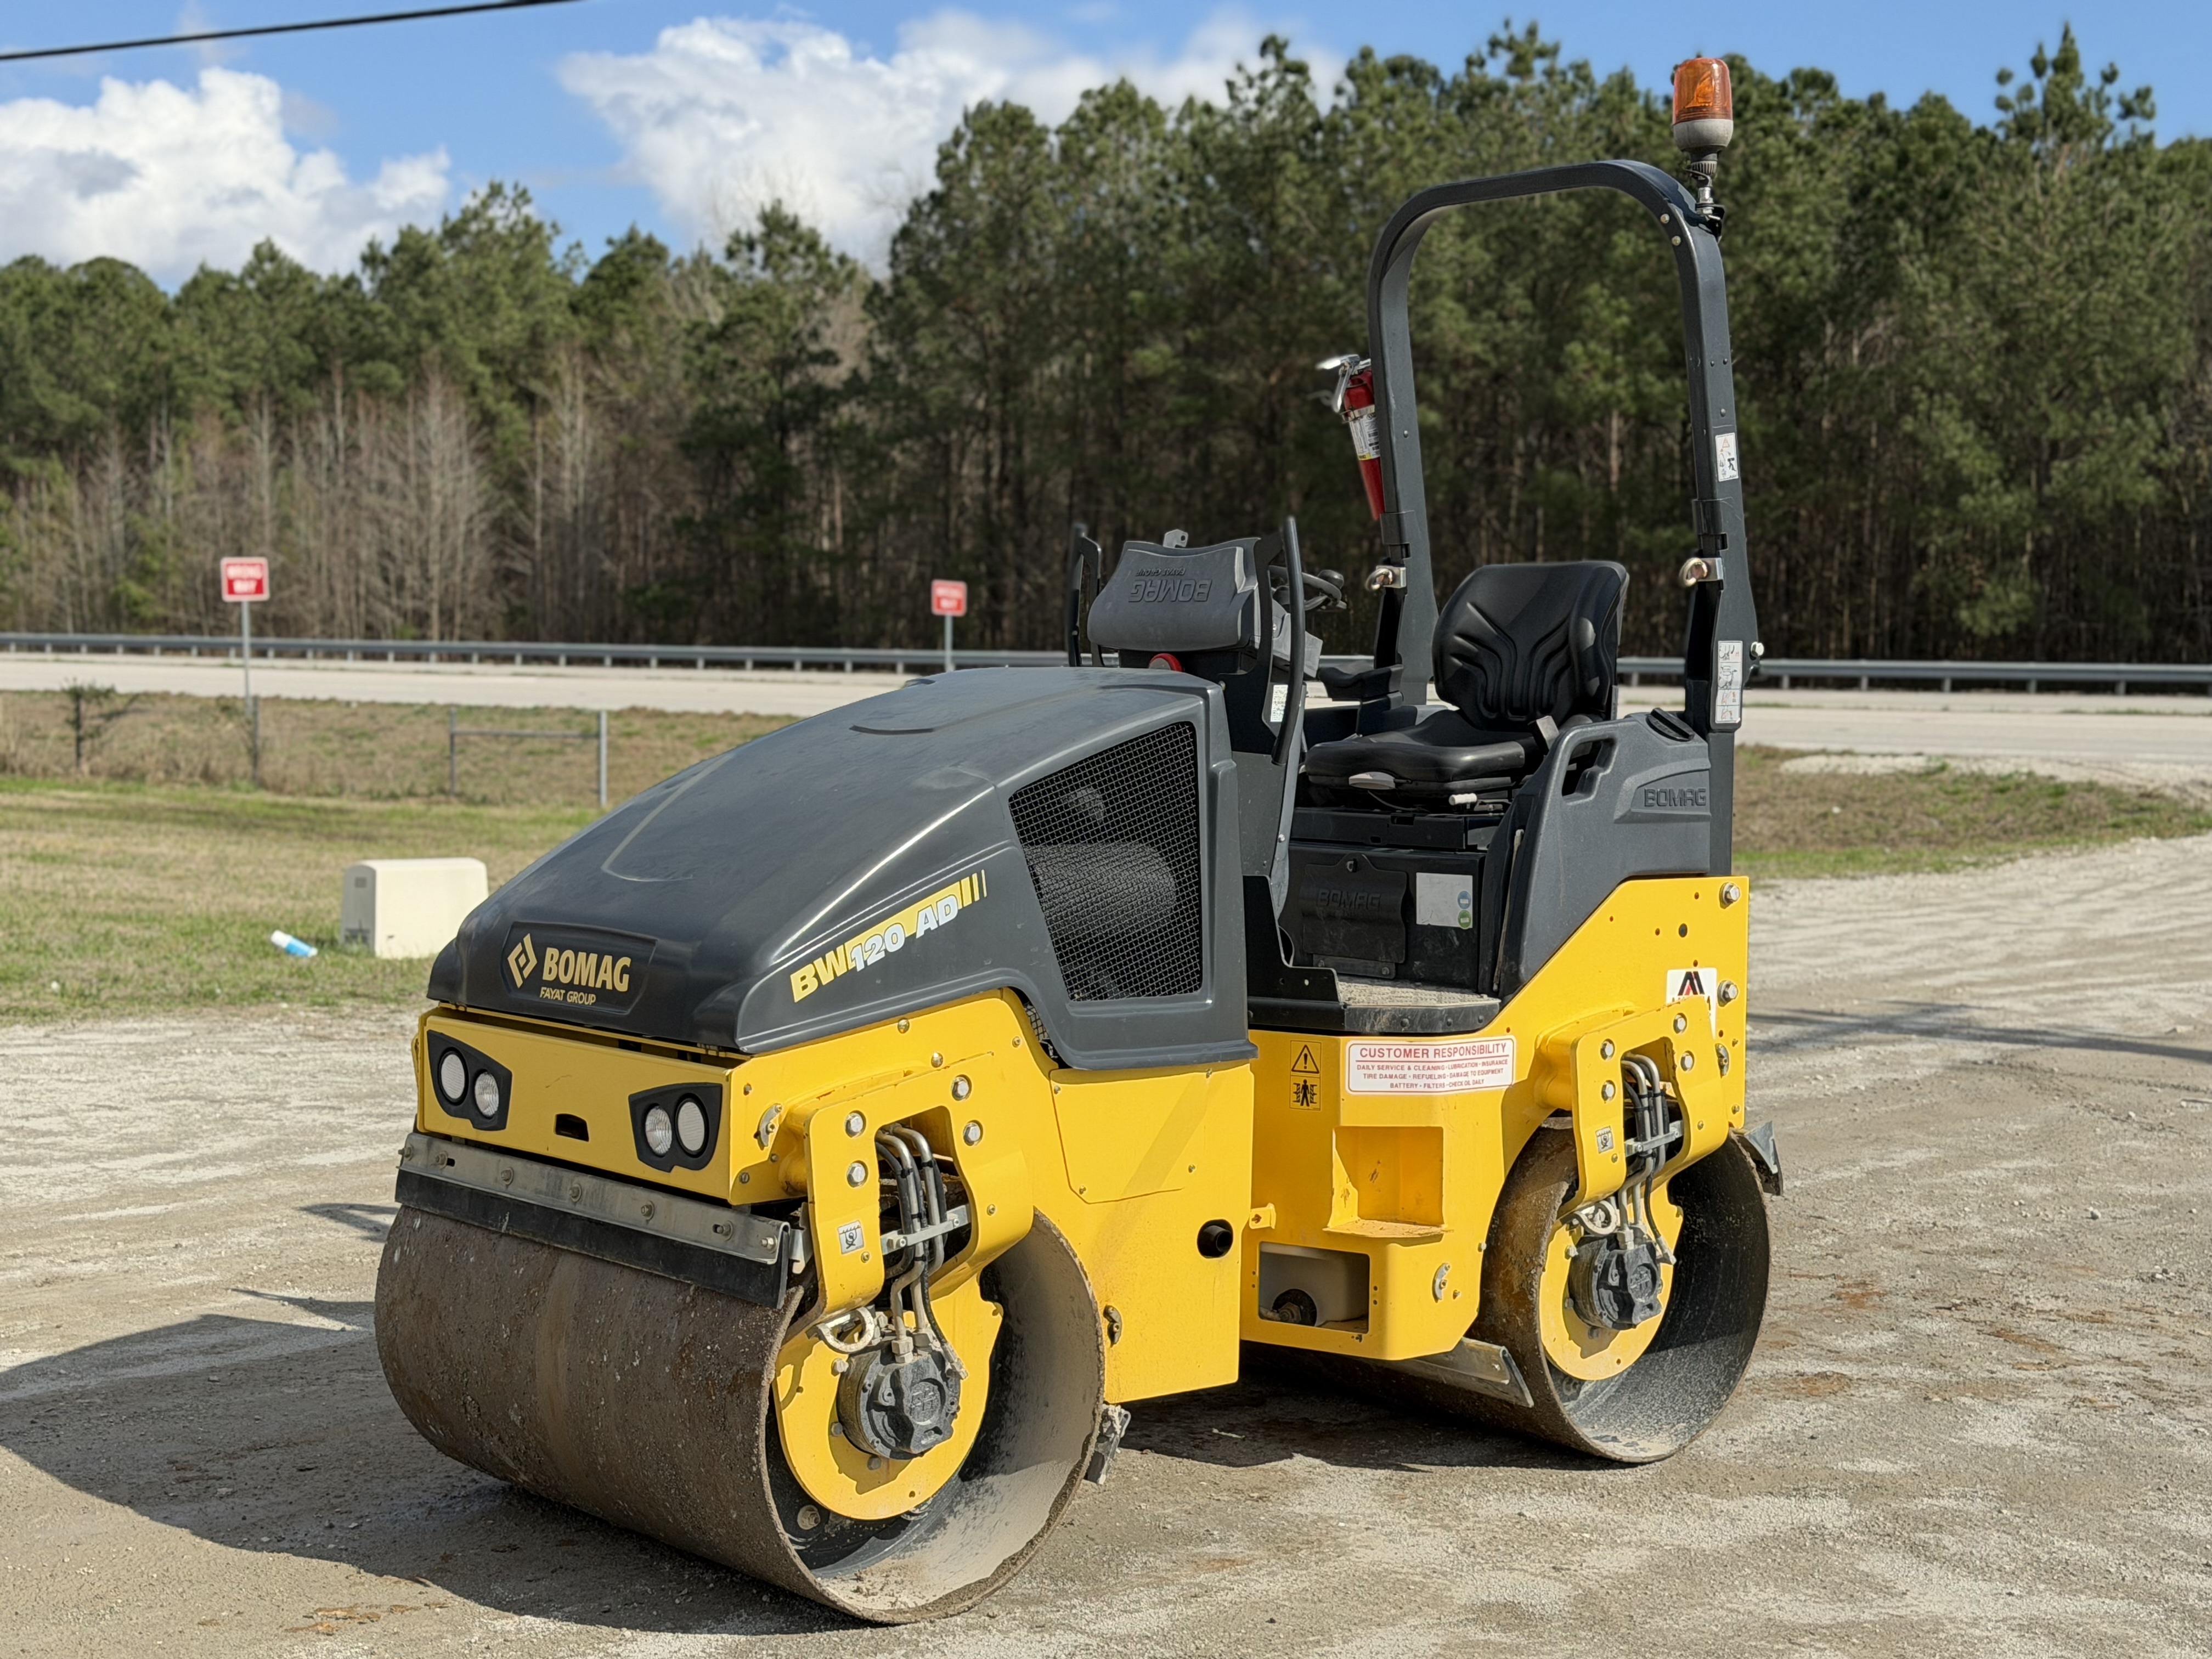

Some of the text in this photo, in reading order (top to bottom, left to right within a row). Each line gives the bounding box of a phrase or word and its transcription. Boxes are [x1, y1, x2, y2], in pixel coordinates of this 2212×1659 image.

[1128, 579, 1212, 603] BOMAG
[1644, 788, 1706, 807] BOMAG
[1317, 888, 1381, 910] BOMAG
[916, 894, 958, 939] AD
[542, 947, 631, 992] BOMAG
[540, 987, 596, 1005] FAYAT GROUP
[1360, 1042, 1506, 1058] CUSTOMER RESPONSIBILITY
